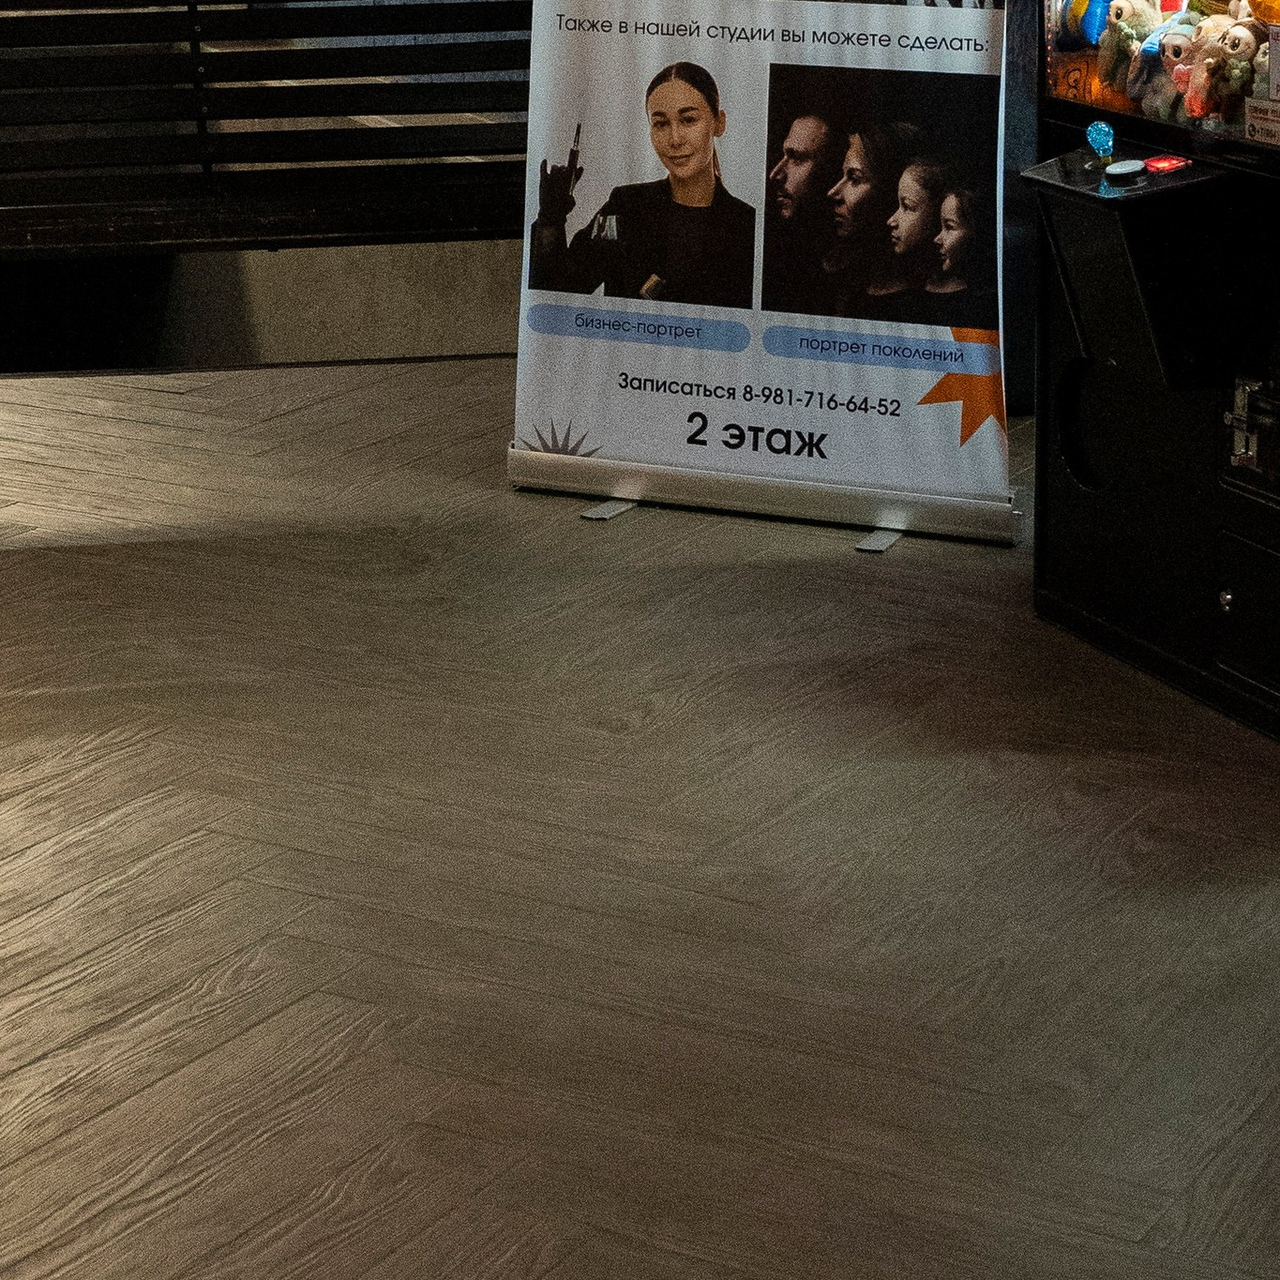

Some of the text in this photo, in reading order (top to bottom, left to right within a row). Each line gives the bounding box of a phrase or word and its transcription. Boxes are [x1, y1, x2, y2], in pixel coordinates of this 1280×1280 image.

[557, 14, 989, 54] Также в нашей студии вы можете сделать:
[575, 313, 702, 340] бизнес-портрет
[799, 336, 965, 363] портрет поколений
[618, 373, 901, 417] Записаться 8-981-716-64-52
[686, 412, 828, 459] 2 этаж
